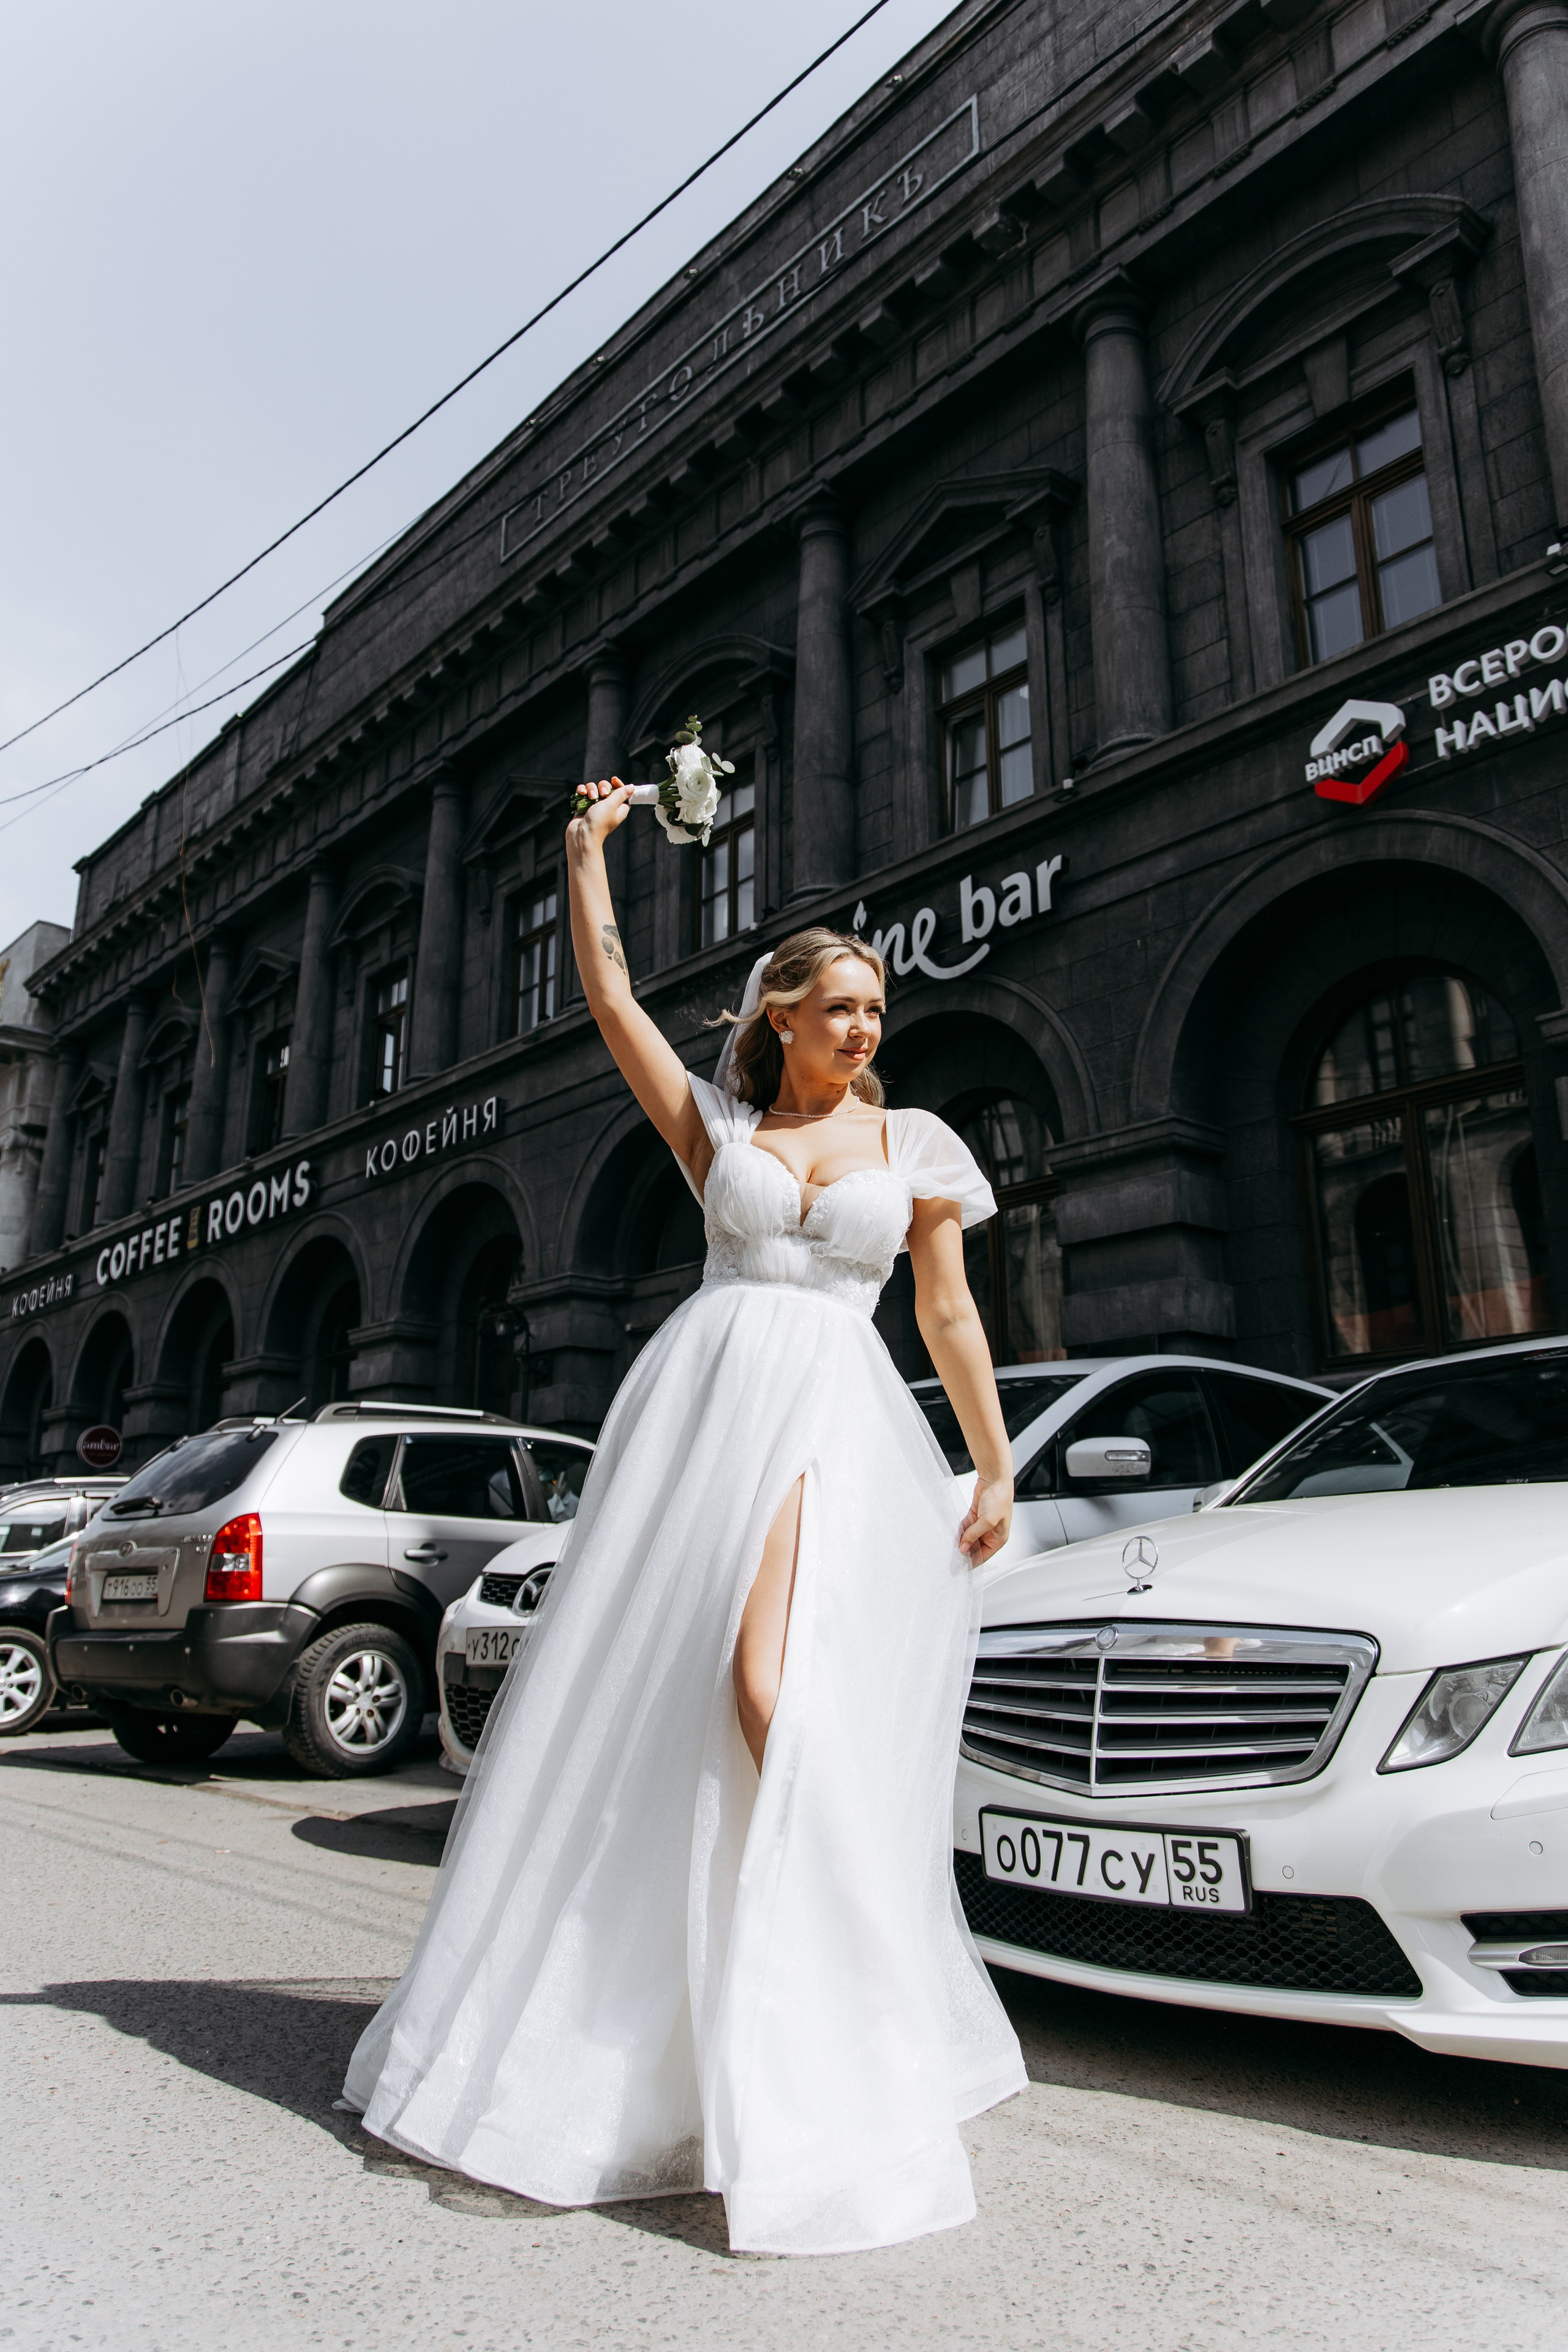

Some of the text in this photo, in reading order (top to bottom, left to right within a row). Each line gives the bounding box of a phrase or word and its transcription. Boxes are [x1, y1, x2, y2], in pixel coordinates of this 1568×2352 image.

[1428, 622, 1568, 710] ВСЕРО
[1434, 677, 1568, 760] НАЦИ
[1305, 735, 1384, 783] ВЦНСП
[960, 854, 1062, 944] bar
[365, 1096, 497, 1178] КОФЕЙНЯ
[96, 1161, 311, 1286] COFFEE ROOMS
[12, 1274, 73, 1317] КОФЕЙНЯ
[83, 1438, 119, 1451] ambar
[145, 1577, 157, 1591] 55
[1170, 1839, 1223, 1885] 55
[1183, 1887, 1220, 1903] RUS
